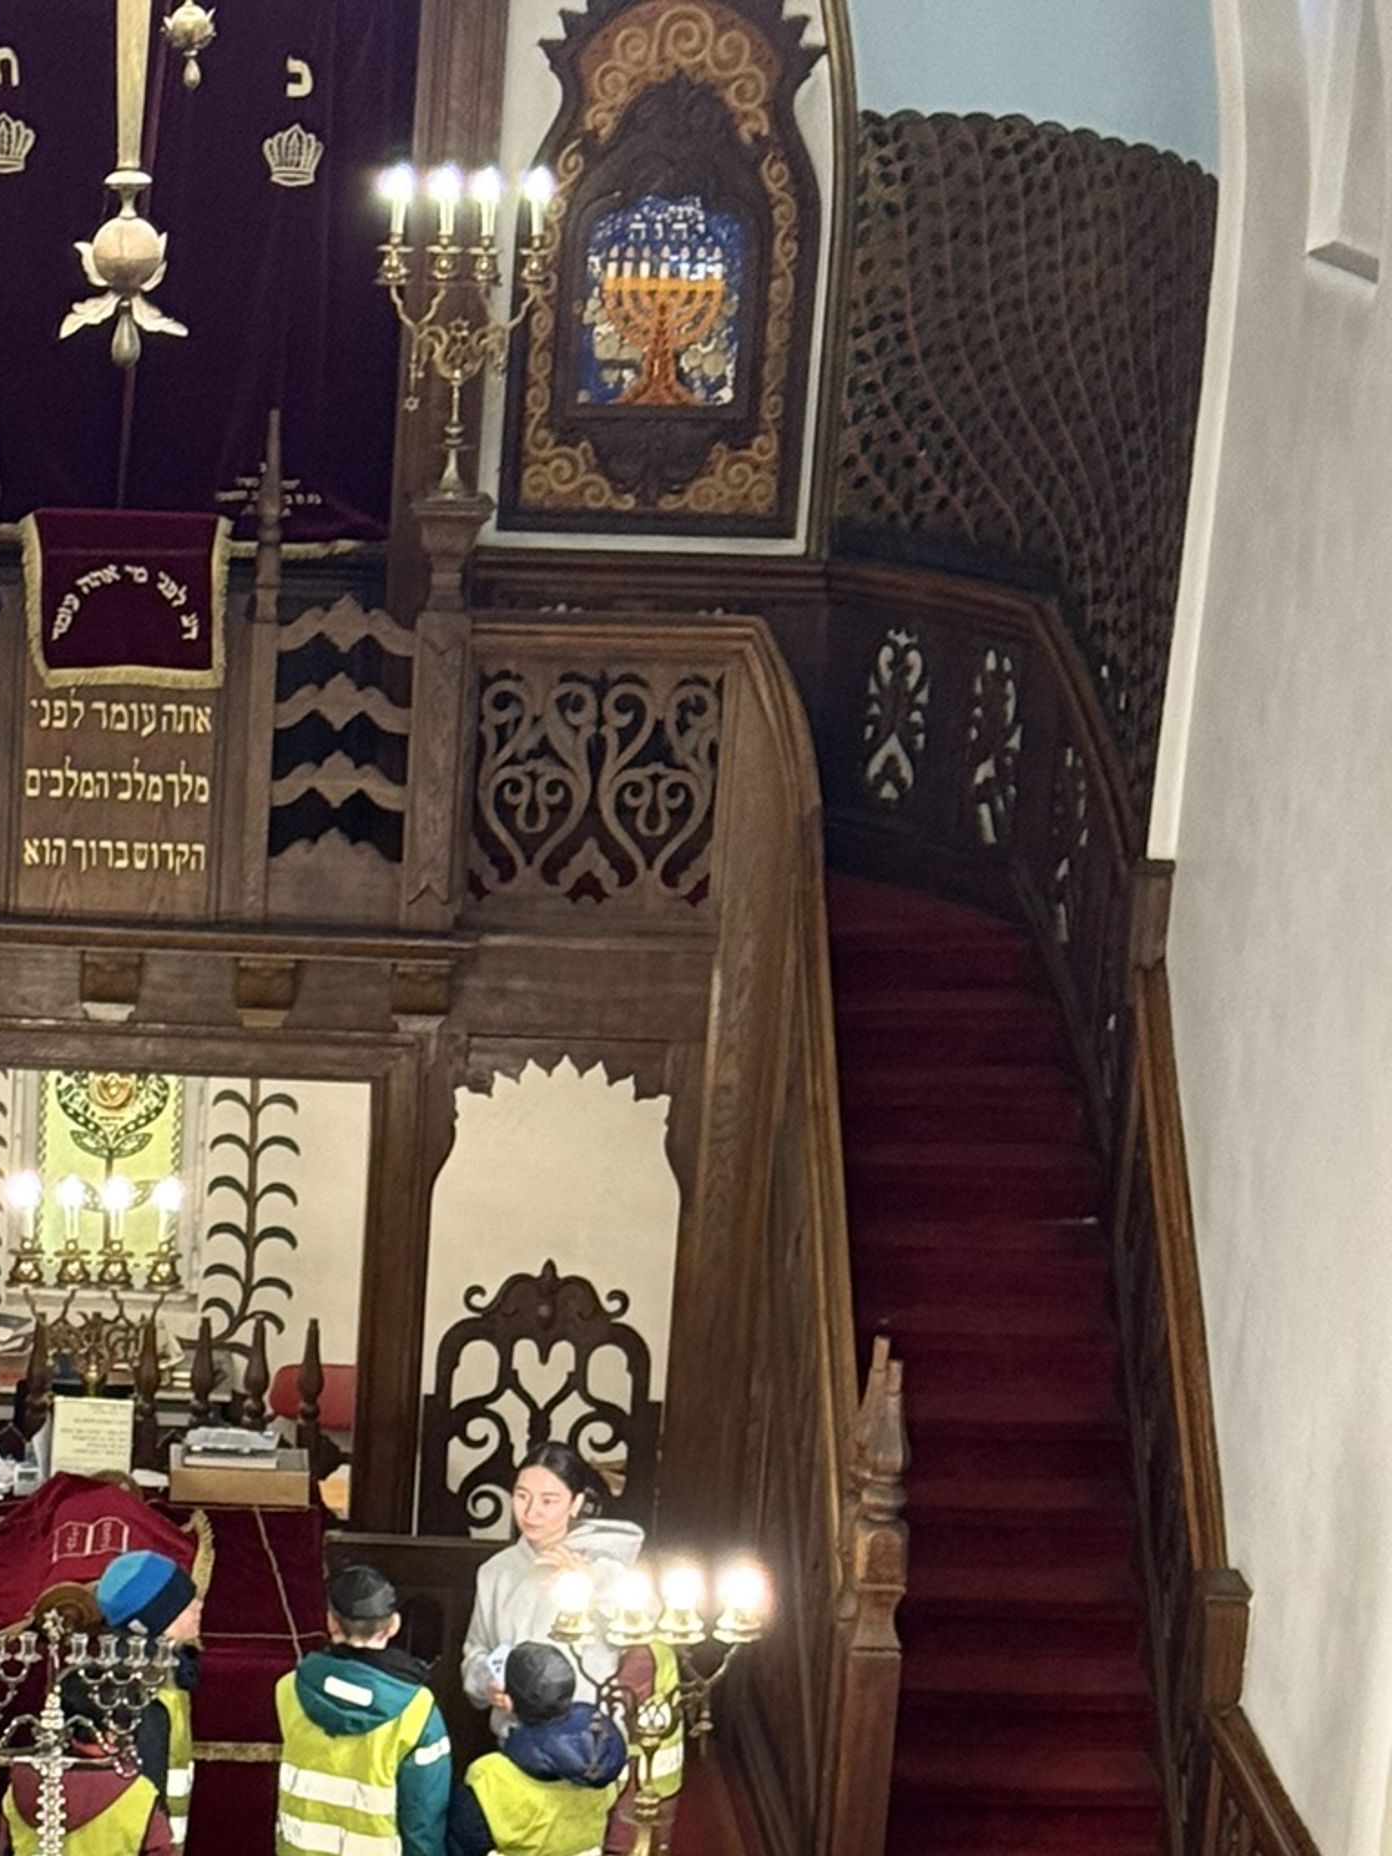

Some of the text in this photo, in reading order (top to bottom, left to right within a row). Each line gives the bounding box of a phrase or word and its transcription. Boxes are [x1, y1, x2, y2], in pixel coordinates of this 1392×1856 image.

[124, 564, 149, 584] מי
[30, 687, 212, 737] אתה עומד לפני
[25, 755, 209, 808] מלך מלכי המלכים
[23, 837, 206, 876] הקדוש ברוך הוא
